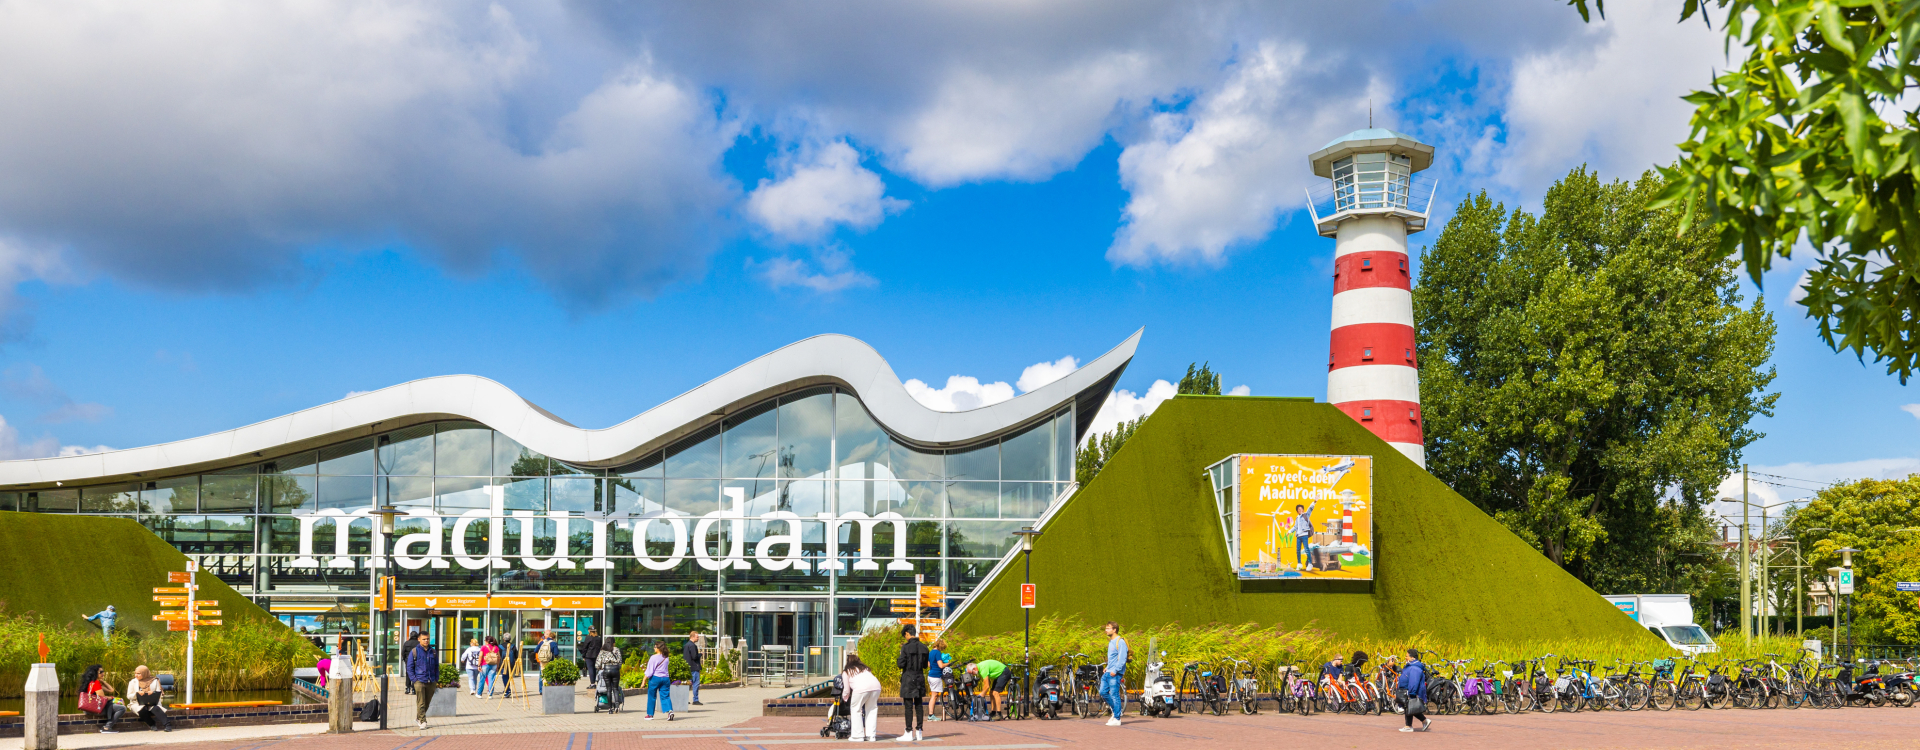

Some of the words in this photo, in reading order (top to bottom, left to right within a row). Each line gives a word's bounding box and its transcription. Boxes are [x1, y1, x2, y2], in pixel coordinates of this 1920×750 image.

[1264, 470, 1302, 484] zoveel
[1309, 471, 1335, 484] doen
[1259, 485, 1336, 501] Madurodam
[291, 485, 914, 571] madurodam
[457, 598, 476, 606] Register
